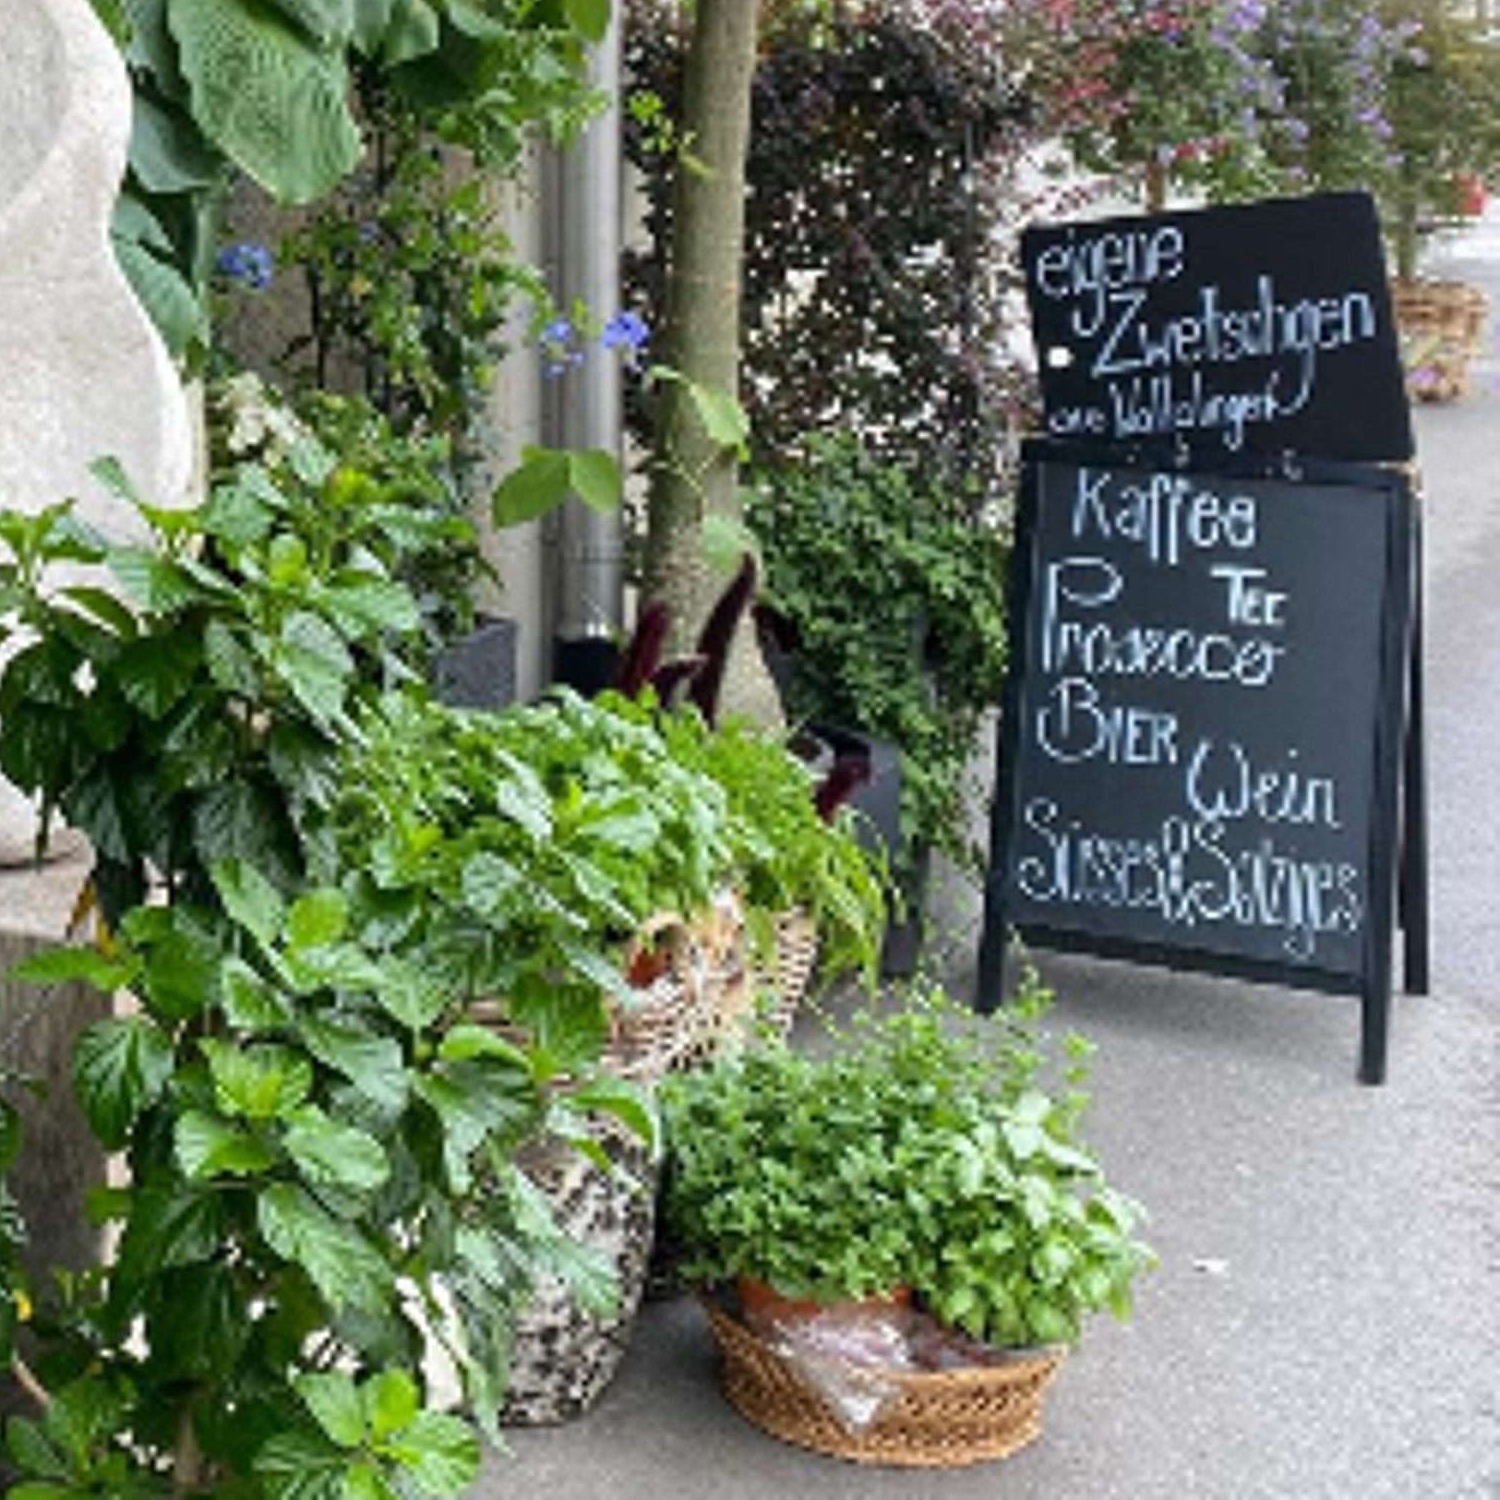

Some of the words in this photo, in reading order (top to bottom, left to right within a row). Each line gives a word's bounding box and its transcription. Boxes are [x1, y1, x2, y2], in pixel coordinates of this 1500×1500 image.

[1036, 226, 1183, 338] eigene
[1073, 468, 1256, 565] Kaffee
[1042, 557, 1286, 685] Prosecco
[1037, 676, 1178, 764] BIER
[1187, 740, 1342, 828] Wein
